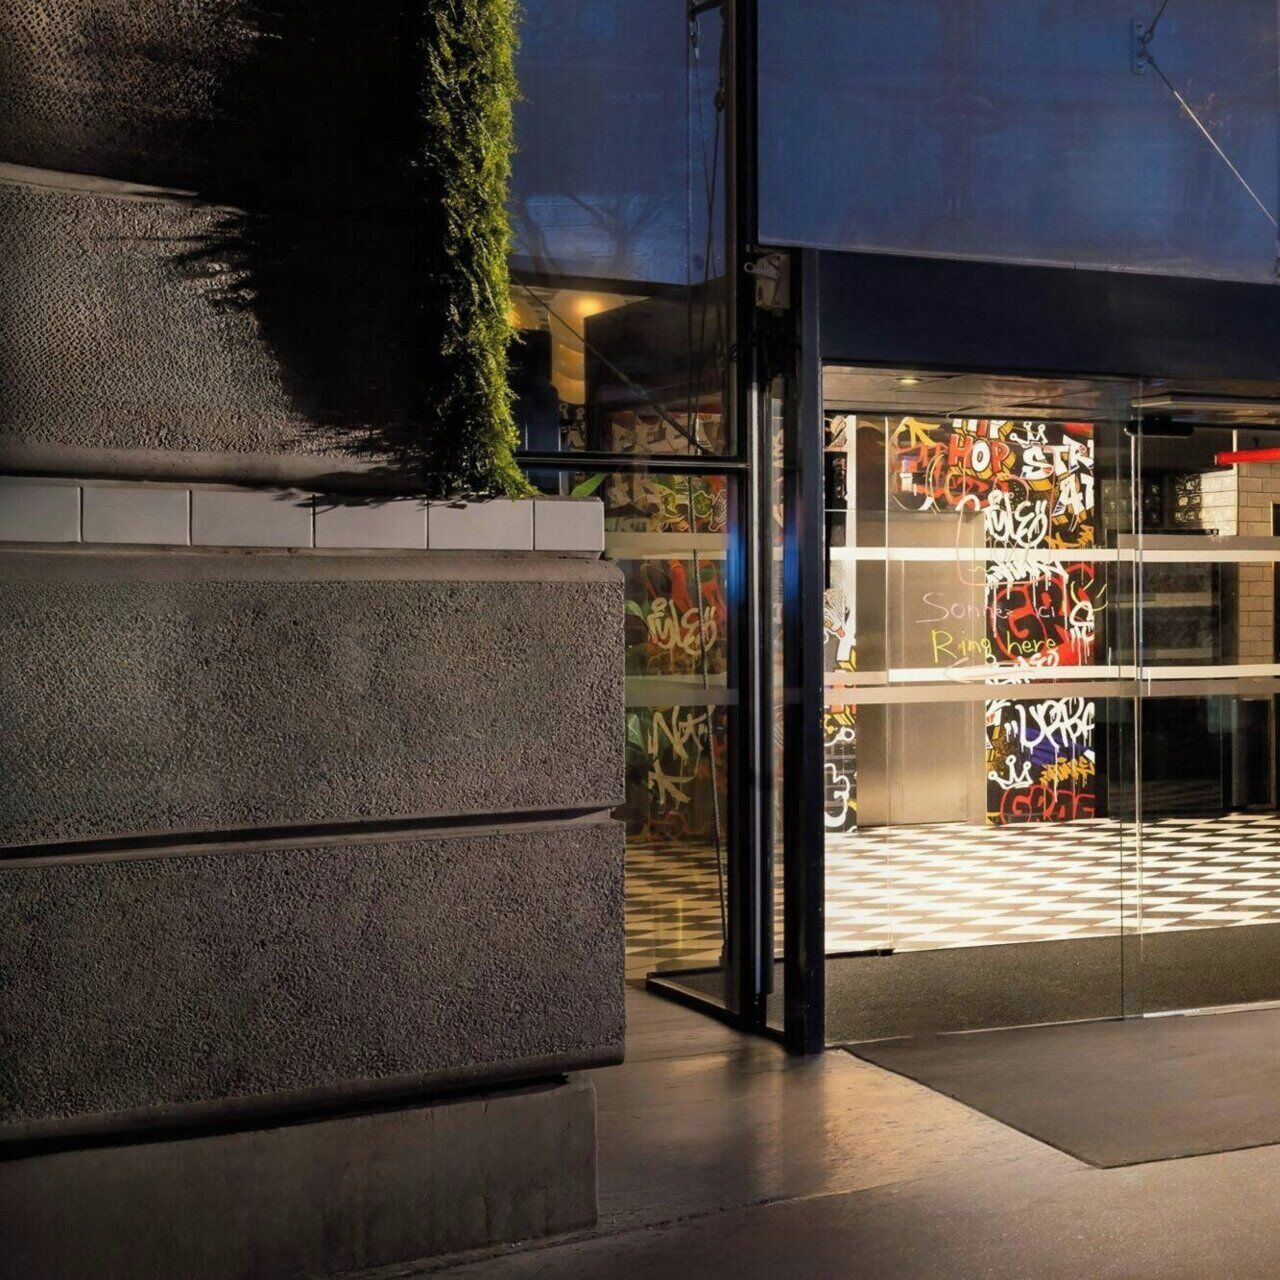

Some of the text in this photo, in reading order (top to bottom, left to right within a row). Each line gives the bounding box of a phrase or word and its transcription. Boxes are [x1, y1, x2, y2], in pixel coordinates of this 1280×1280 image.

[949, 433, 1011, 475] HOP
[931, 629, 1056, 664] Ring here
